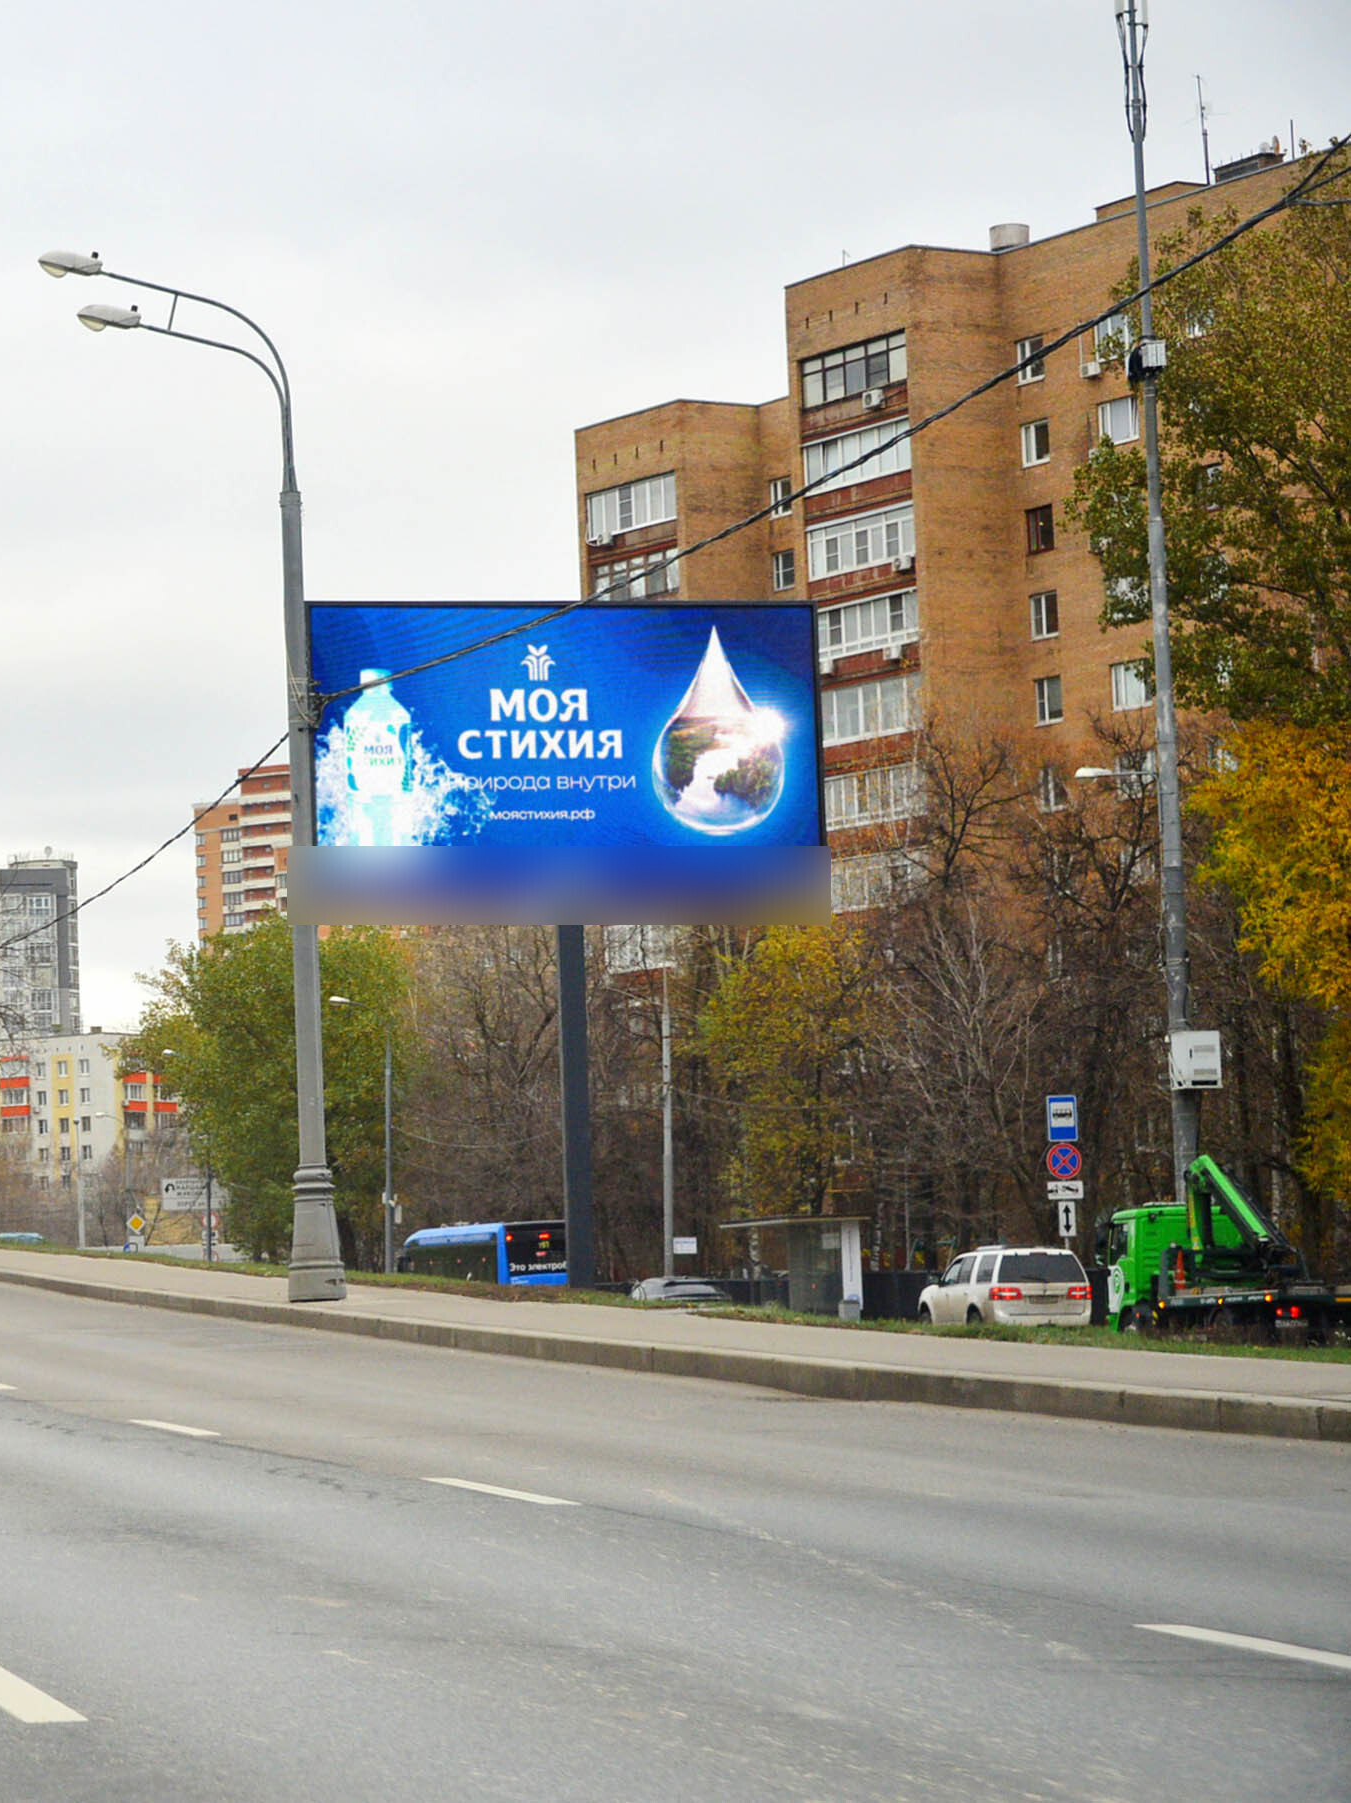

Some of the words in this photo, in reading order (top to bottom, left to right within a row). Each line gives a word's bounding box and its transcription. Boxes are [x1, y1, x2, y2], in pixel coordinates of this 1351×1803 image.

[489, 688, 588, 722] МОЯ
[457, 729, 622, 760] СТИХИЯ
[453, 775, 550, 793] рирода
[556, 775, 636, 793] внутри
[489, 807, 595, 822] моястихия.рф
[509, 1263, 526, 1272] Это
